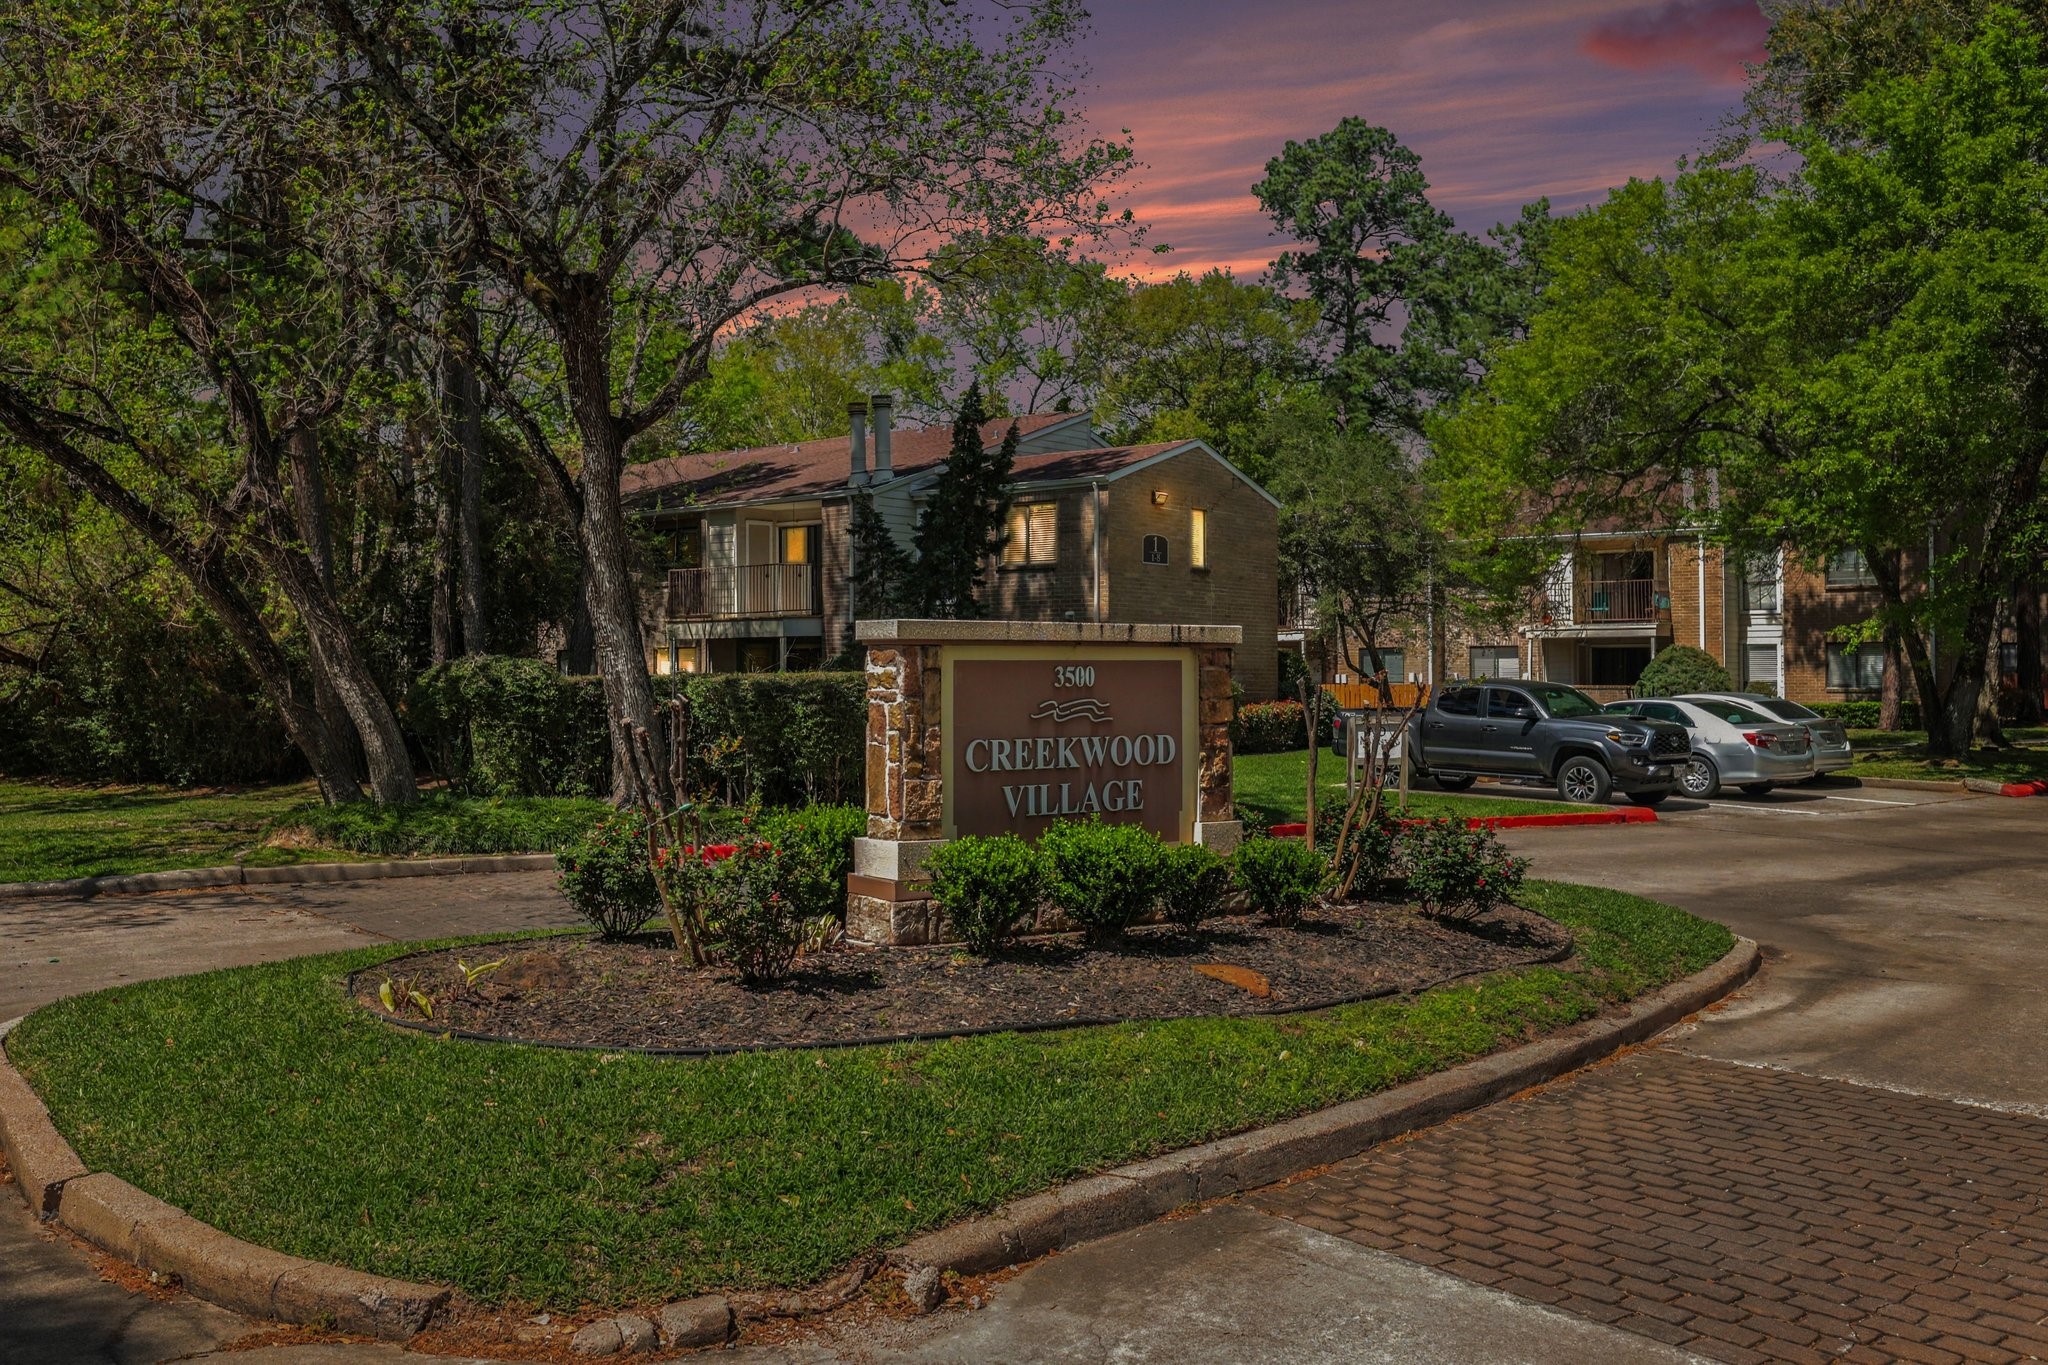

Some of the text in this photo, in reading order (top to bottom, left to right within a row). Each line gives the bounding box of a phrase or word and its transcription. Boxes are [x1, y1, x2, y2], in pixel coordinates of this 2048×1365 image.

[1152, 536, 1158, 552] 1
[1054, 665, 1096, 688] 3500
[965, 734, 1176, 773] CREEKWOOD
[1002, 779, 1144, 818] VILLAGE
